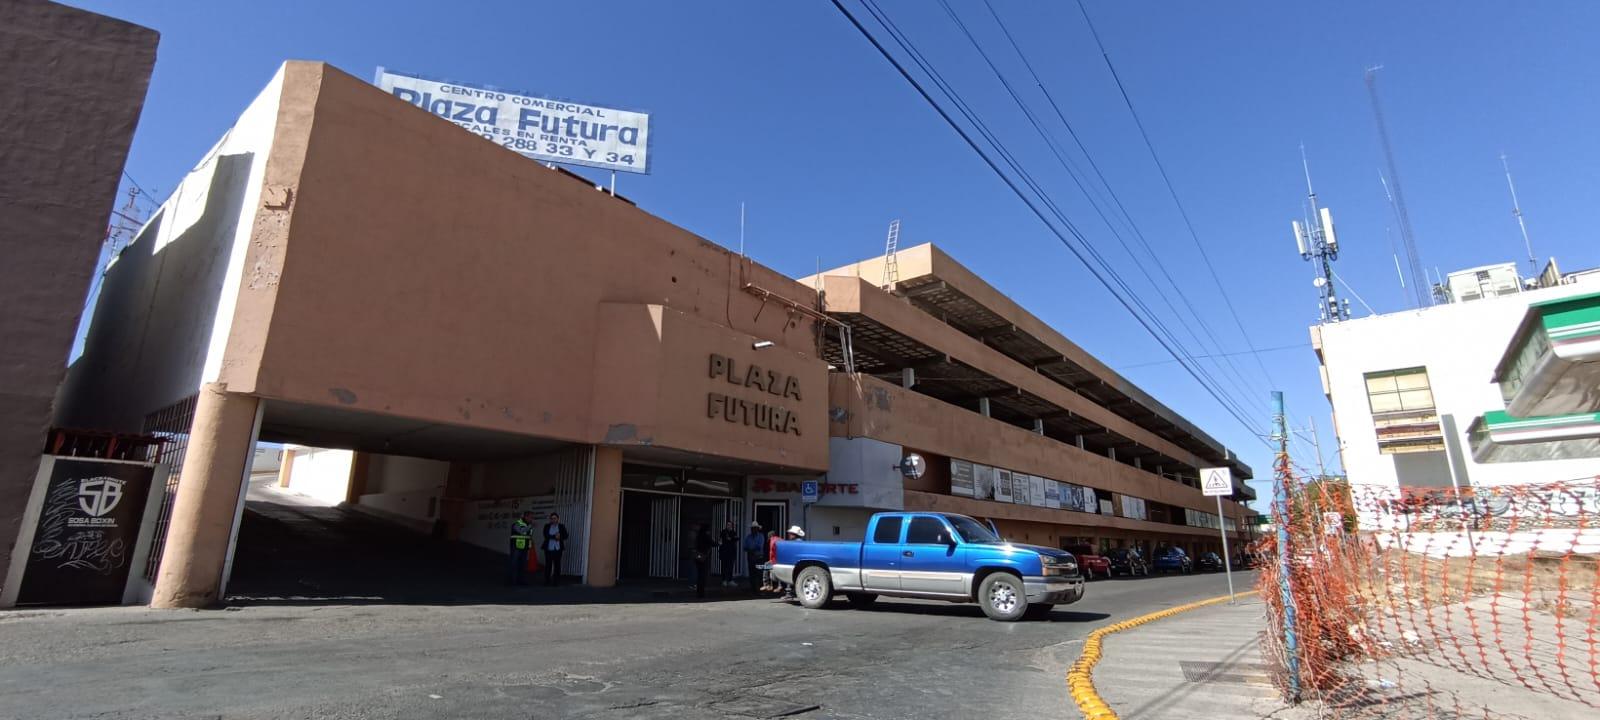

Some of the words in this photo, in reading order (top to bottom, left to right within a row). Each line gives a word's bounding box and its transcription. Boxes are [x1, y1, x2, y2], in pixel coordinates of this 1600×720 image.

[440, 84, 506, 102] CENTRO
[512, 96, 605, 118] COMERCIAL
[517, 130, 535, 140] EN
[540, 133, 588, 148] RENTA
[518, 107, 639, 146] Futura
[546, 142, 573, 156] 33
[583, 148, 597, 160] Y
[606, 151, 635, 165] 34
[709, 353, 802, 402] PLAZA
[708, 392, 802, 436] FUTURA
